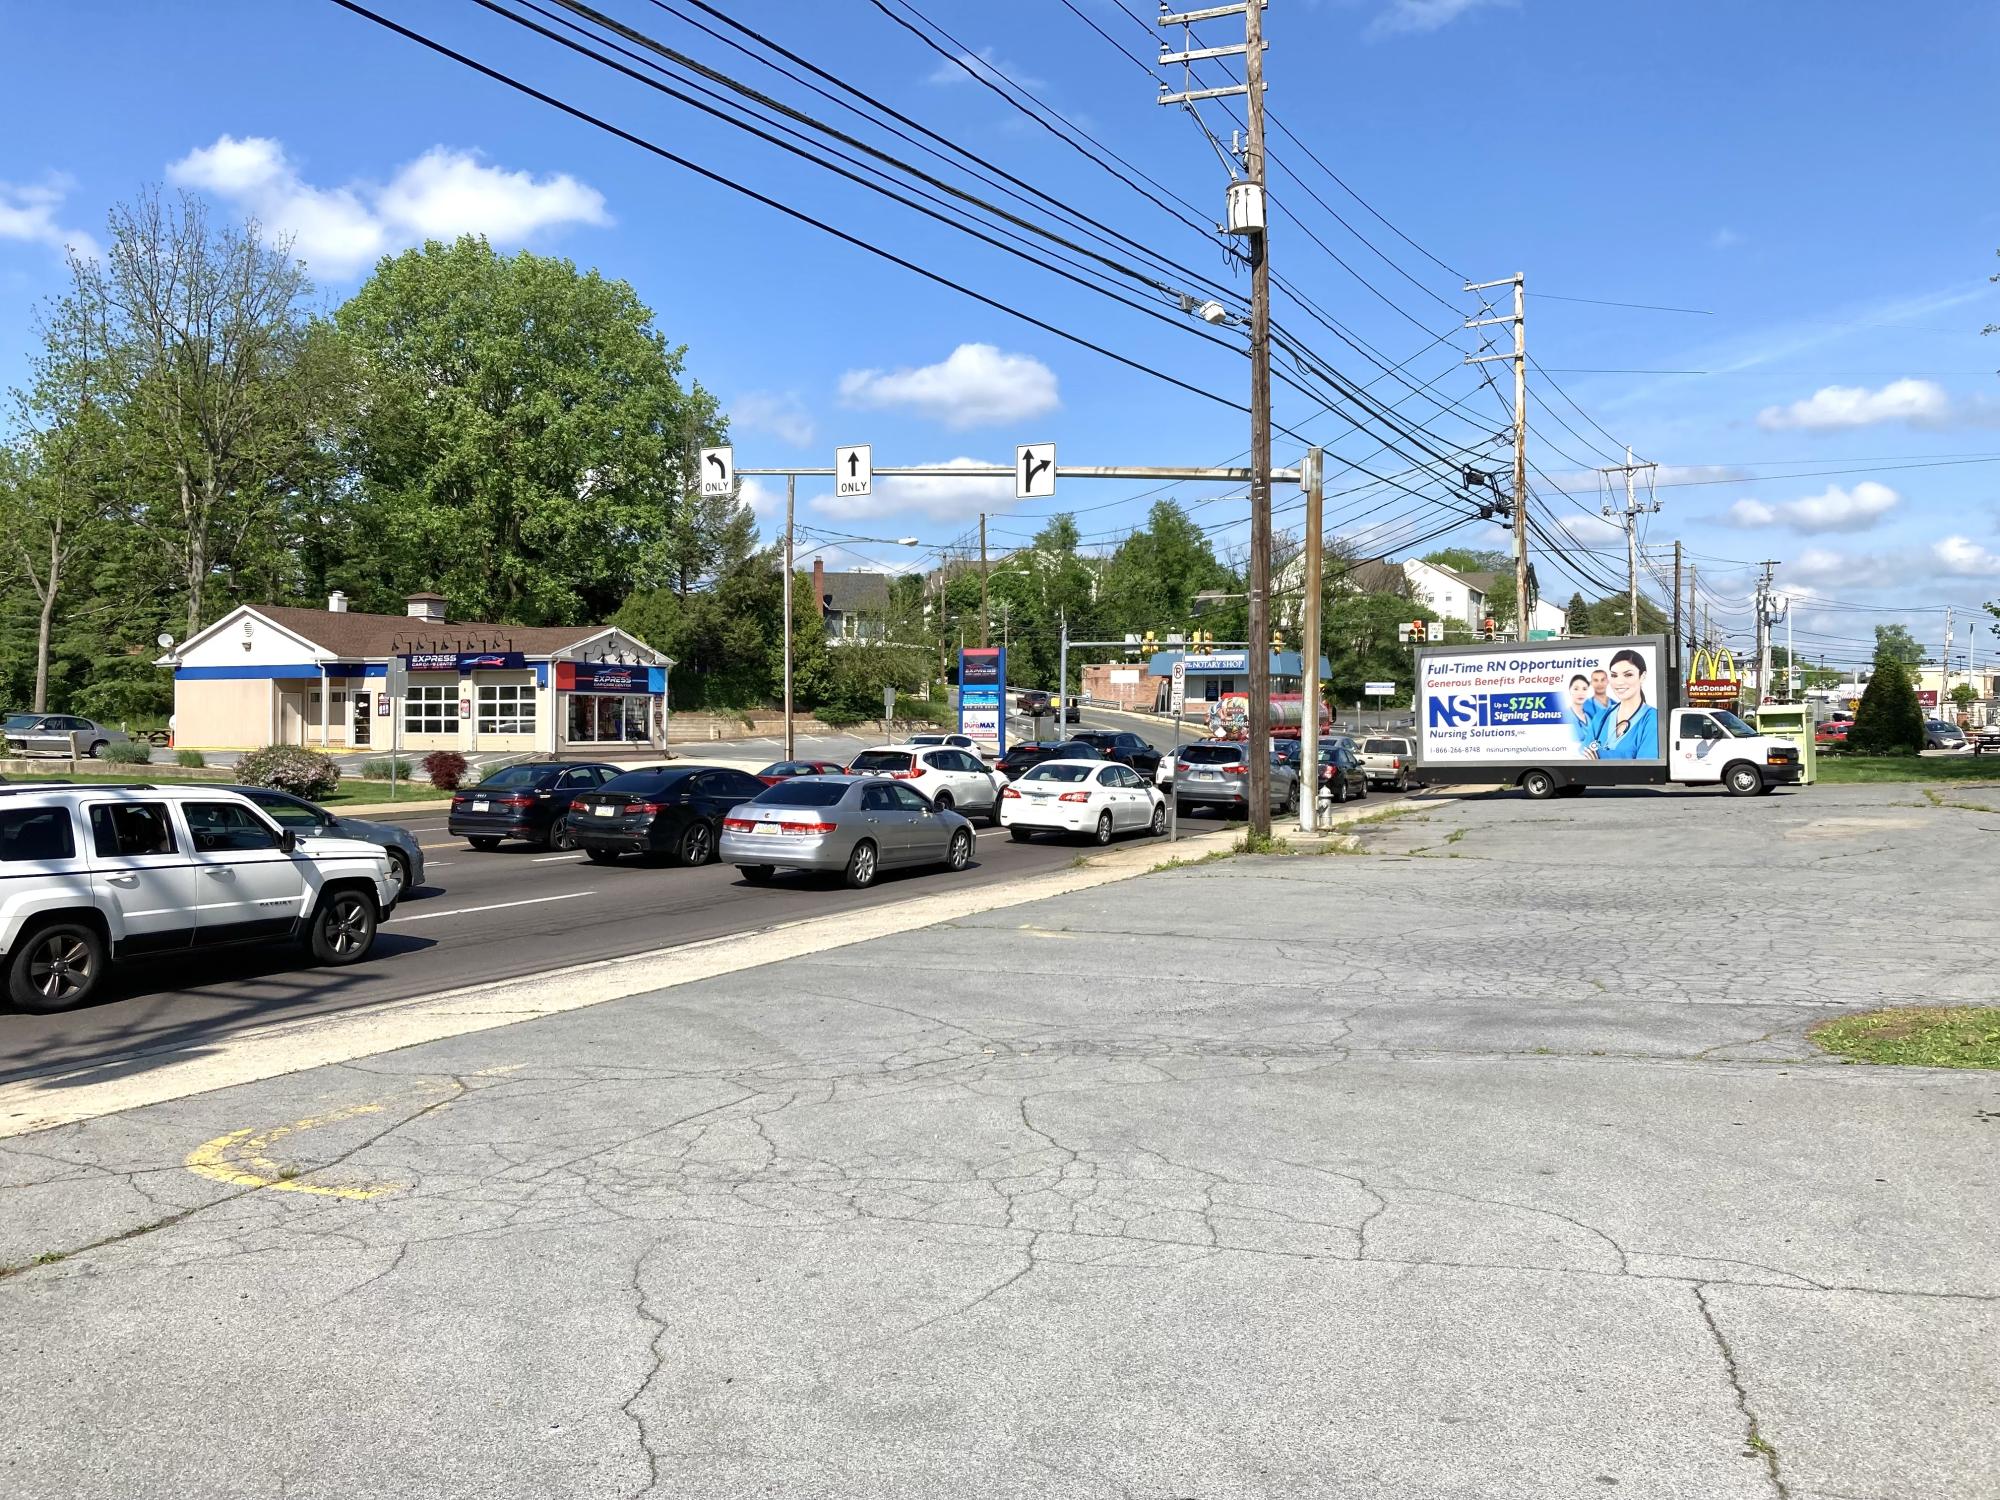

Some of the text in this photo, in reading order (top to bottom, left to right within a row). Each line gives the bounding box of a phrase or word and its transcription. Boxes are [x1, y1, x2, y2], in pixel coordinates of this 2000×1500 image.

[705, 482, 729, 492] ONLY
[841, 482, 867, 493] ONLY
[411, 654, 457, 662] EXPRESS
[1192, 661, 1221, 669] NOTARY
[1222, 660, 1243, 668] SHOP
[1428, 657, 1599, 675] Full-Time RN Opportunities
[594, 675, 631, 684] EXPRESS
[1427, 674, 1564, 688] Generous Benefits Package!
[1509, 696, 1547, 711] $75K
[1494, 710, 1562, 722] Signing Bonus
[1429, 729, 1467, 740] Nursing
[1430, 745, 1567, 755] 1-866-266-8748 nsinursingsolutions.com
